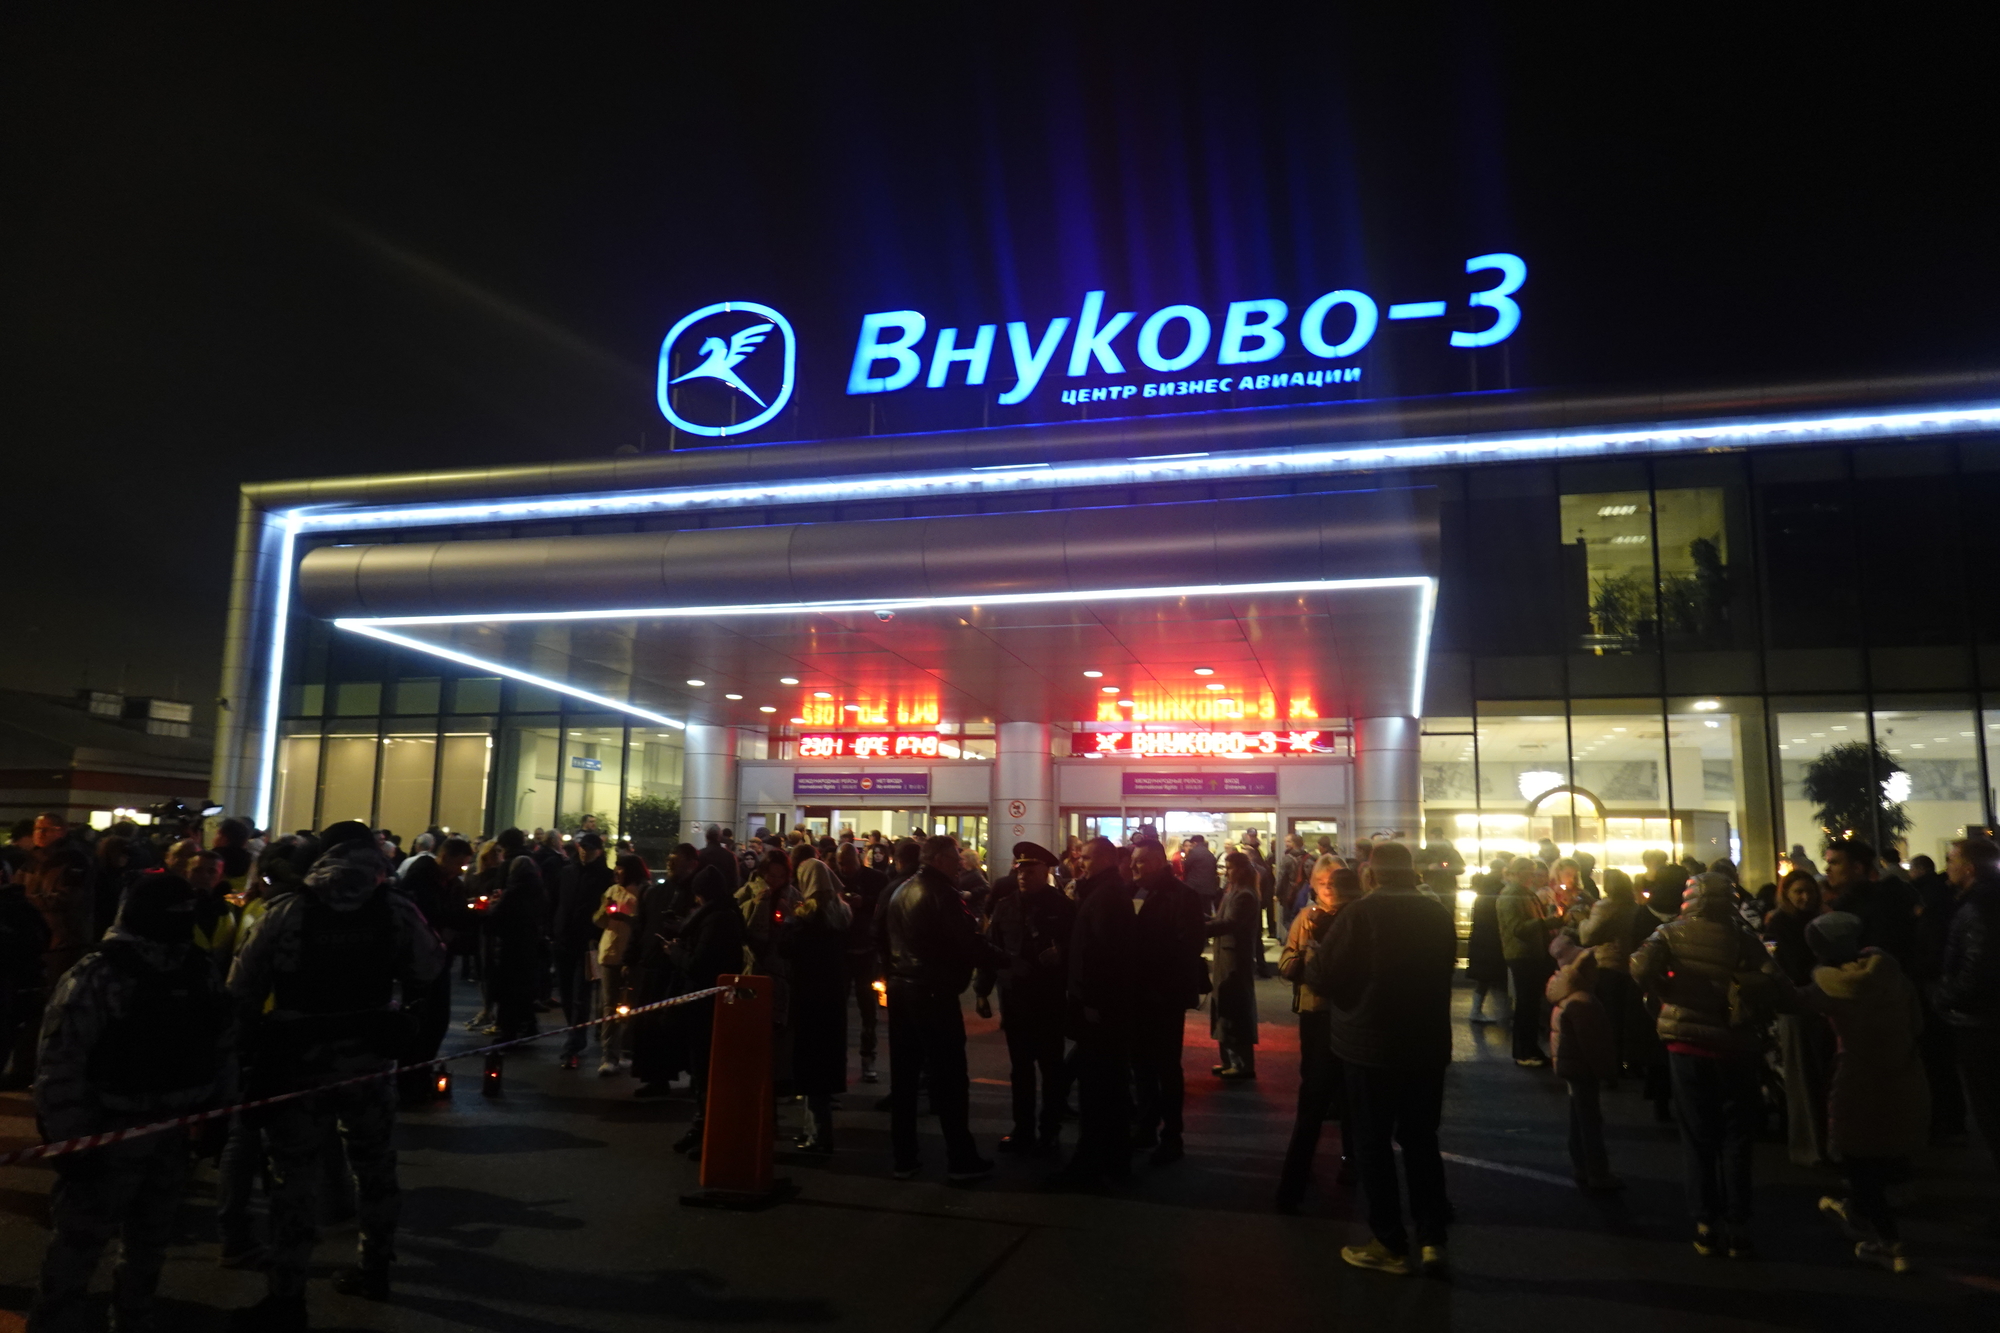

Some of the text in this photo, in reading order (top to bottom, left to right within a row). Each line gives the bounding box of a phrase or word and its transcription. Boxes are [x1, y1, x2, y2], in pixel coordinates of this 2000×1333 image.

[846, 253, 1527, 405] Внуково-3
[1061, 367, 1362, 405] ЦЕНТР БИЗНЕС АВИАЦИИ
[1131, 731, 1277, 754] ВНУКОВО-3
